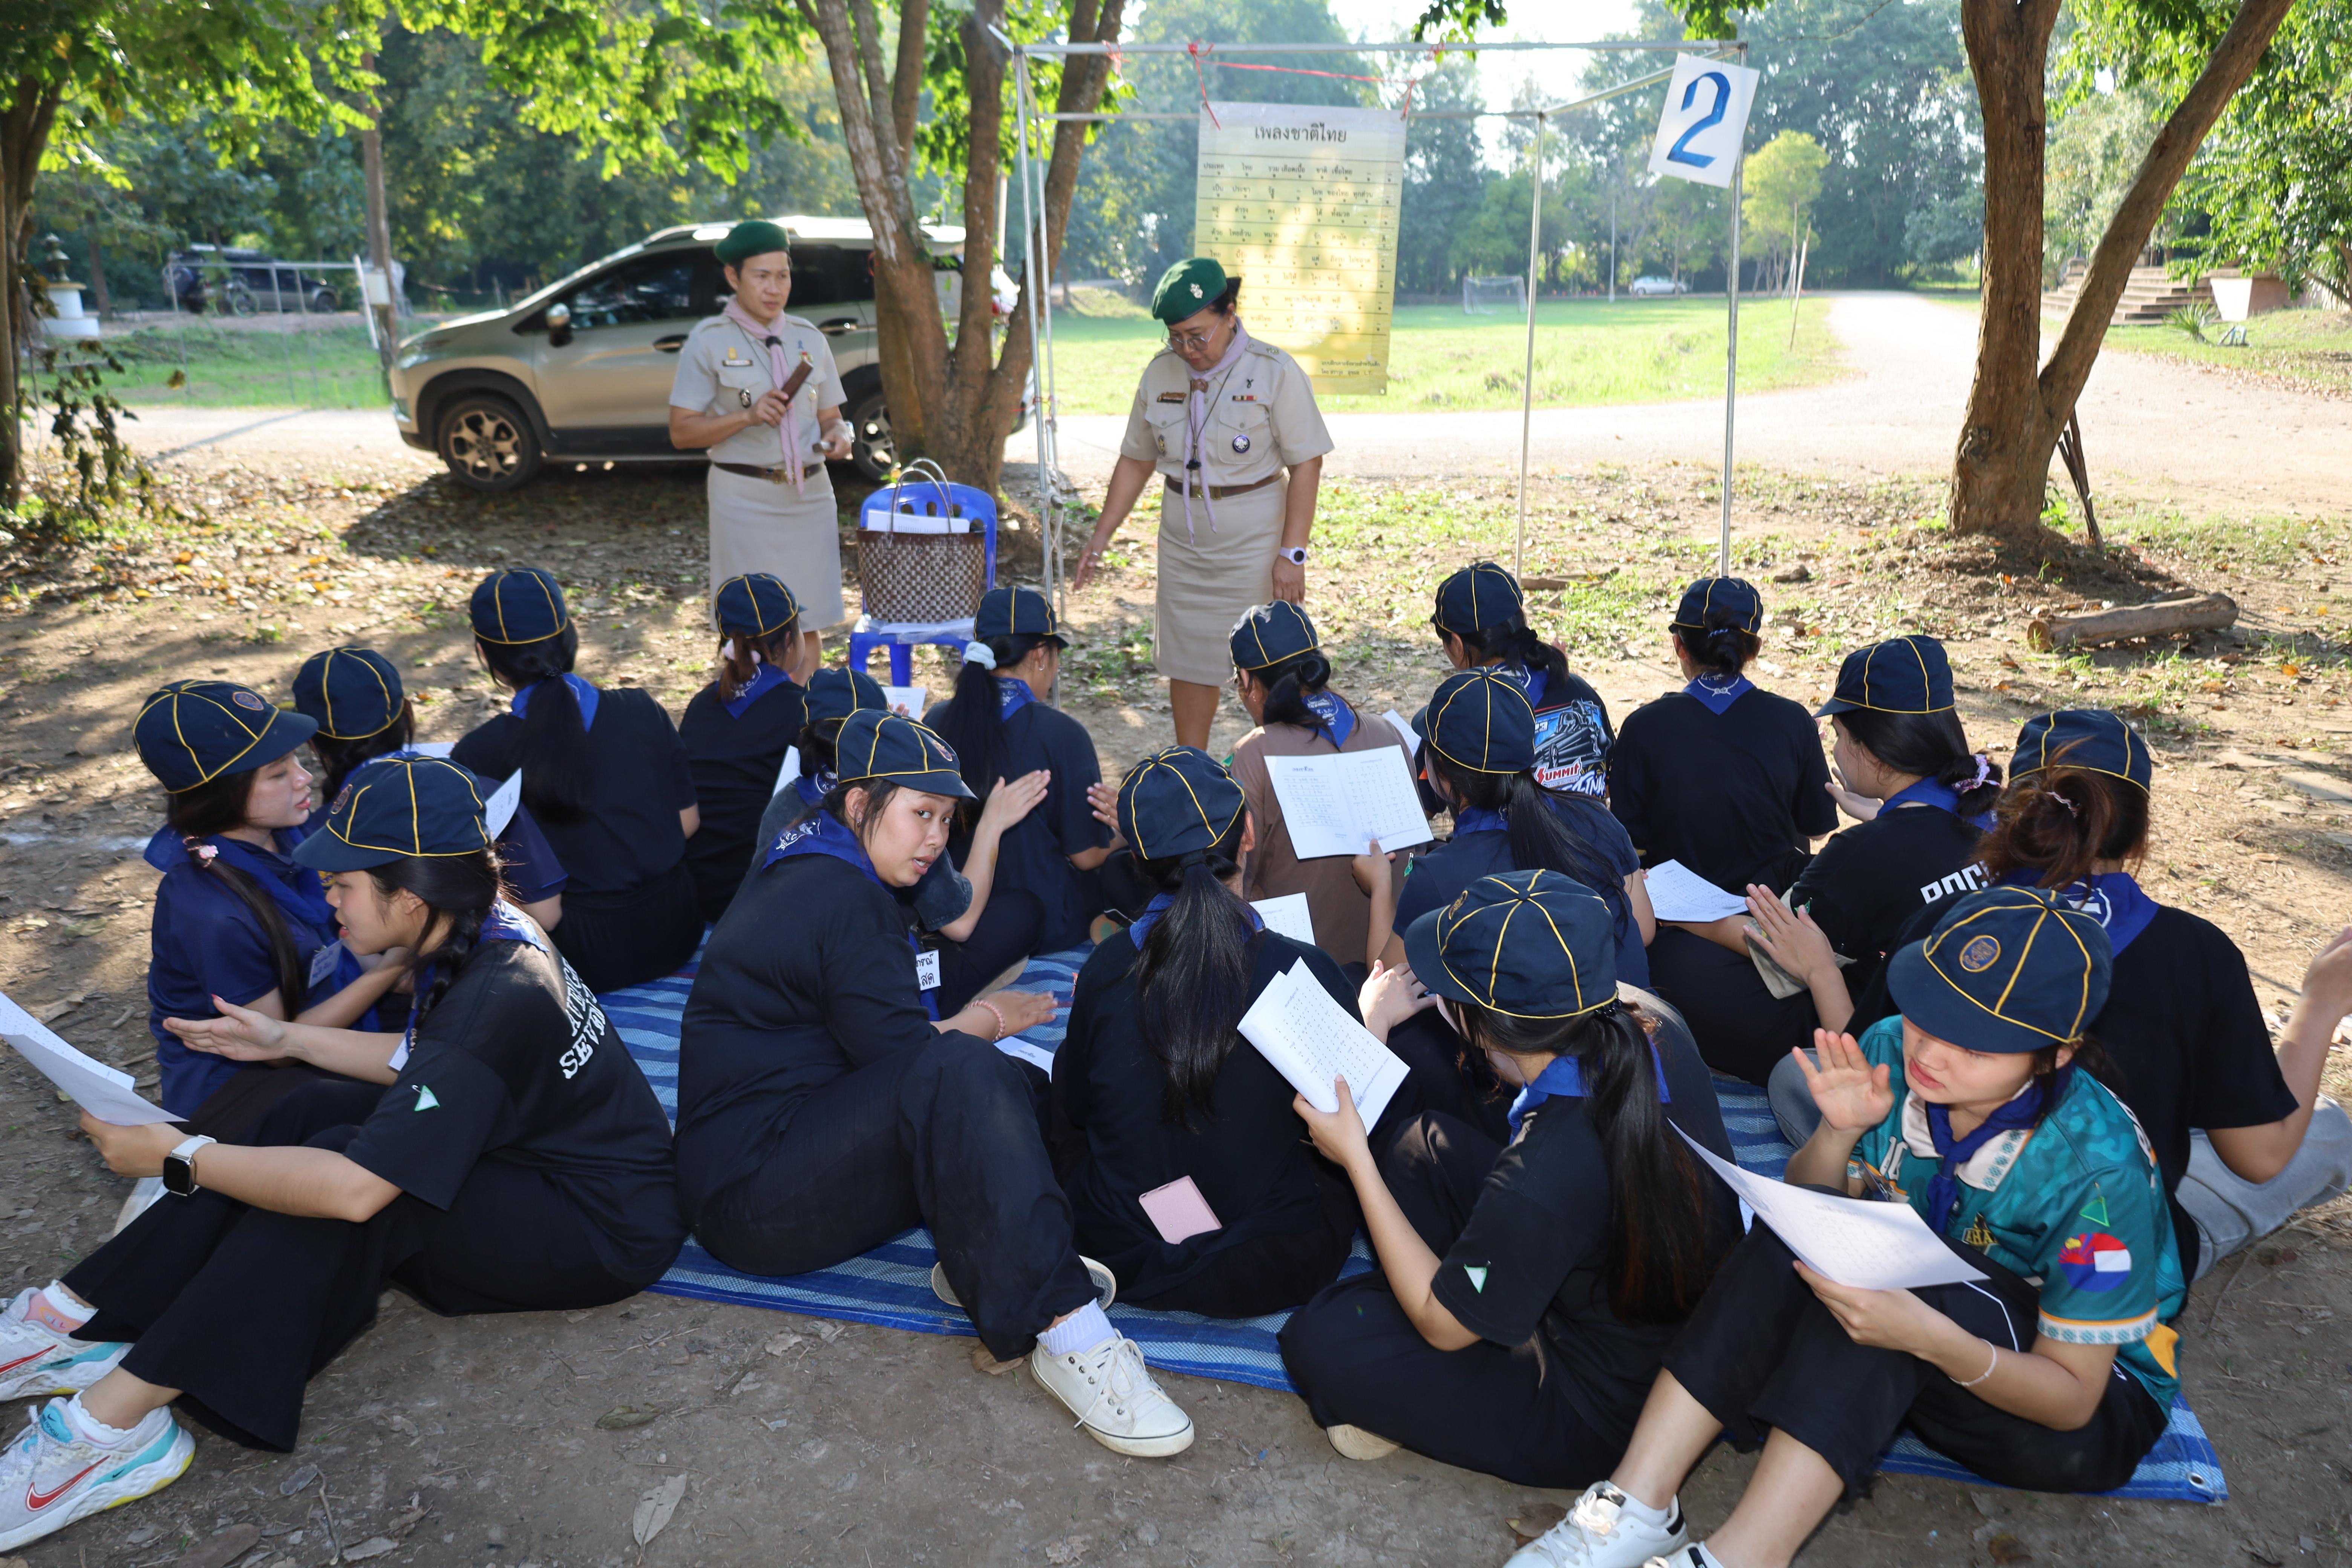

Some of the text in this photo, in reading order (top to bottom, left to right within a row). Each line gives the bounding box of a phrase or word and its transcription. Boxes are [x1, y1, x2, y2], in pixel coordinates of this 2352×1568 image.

[1255, 122, 1347, 142] เพลงชาติไทย
[1667, 72, 1731, 168] 2
